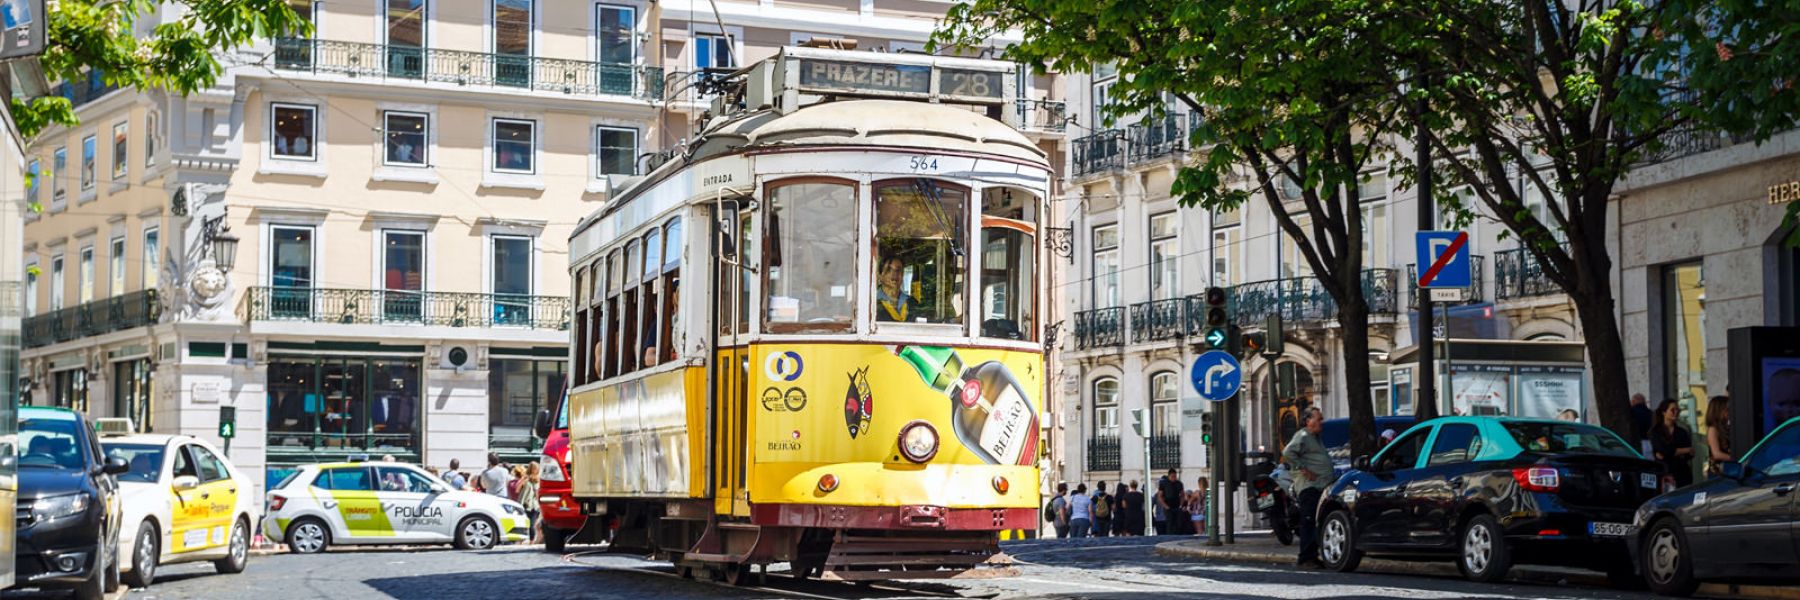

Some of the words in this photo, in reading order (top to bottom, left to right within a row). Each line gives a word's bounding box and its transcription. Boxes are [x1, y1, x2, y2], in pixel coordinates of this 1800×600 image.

[953, 73, 989, 96] 28
[910, 155, 937, 170] 564
[703, 173, 732, 187] ENTRADA
[1768, 181, 1800, 204] HER
